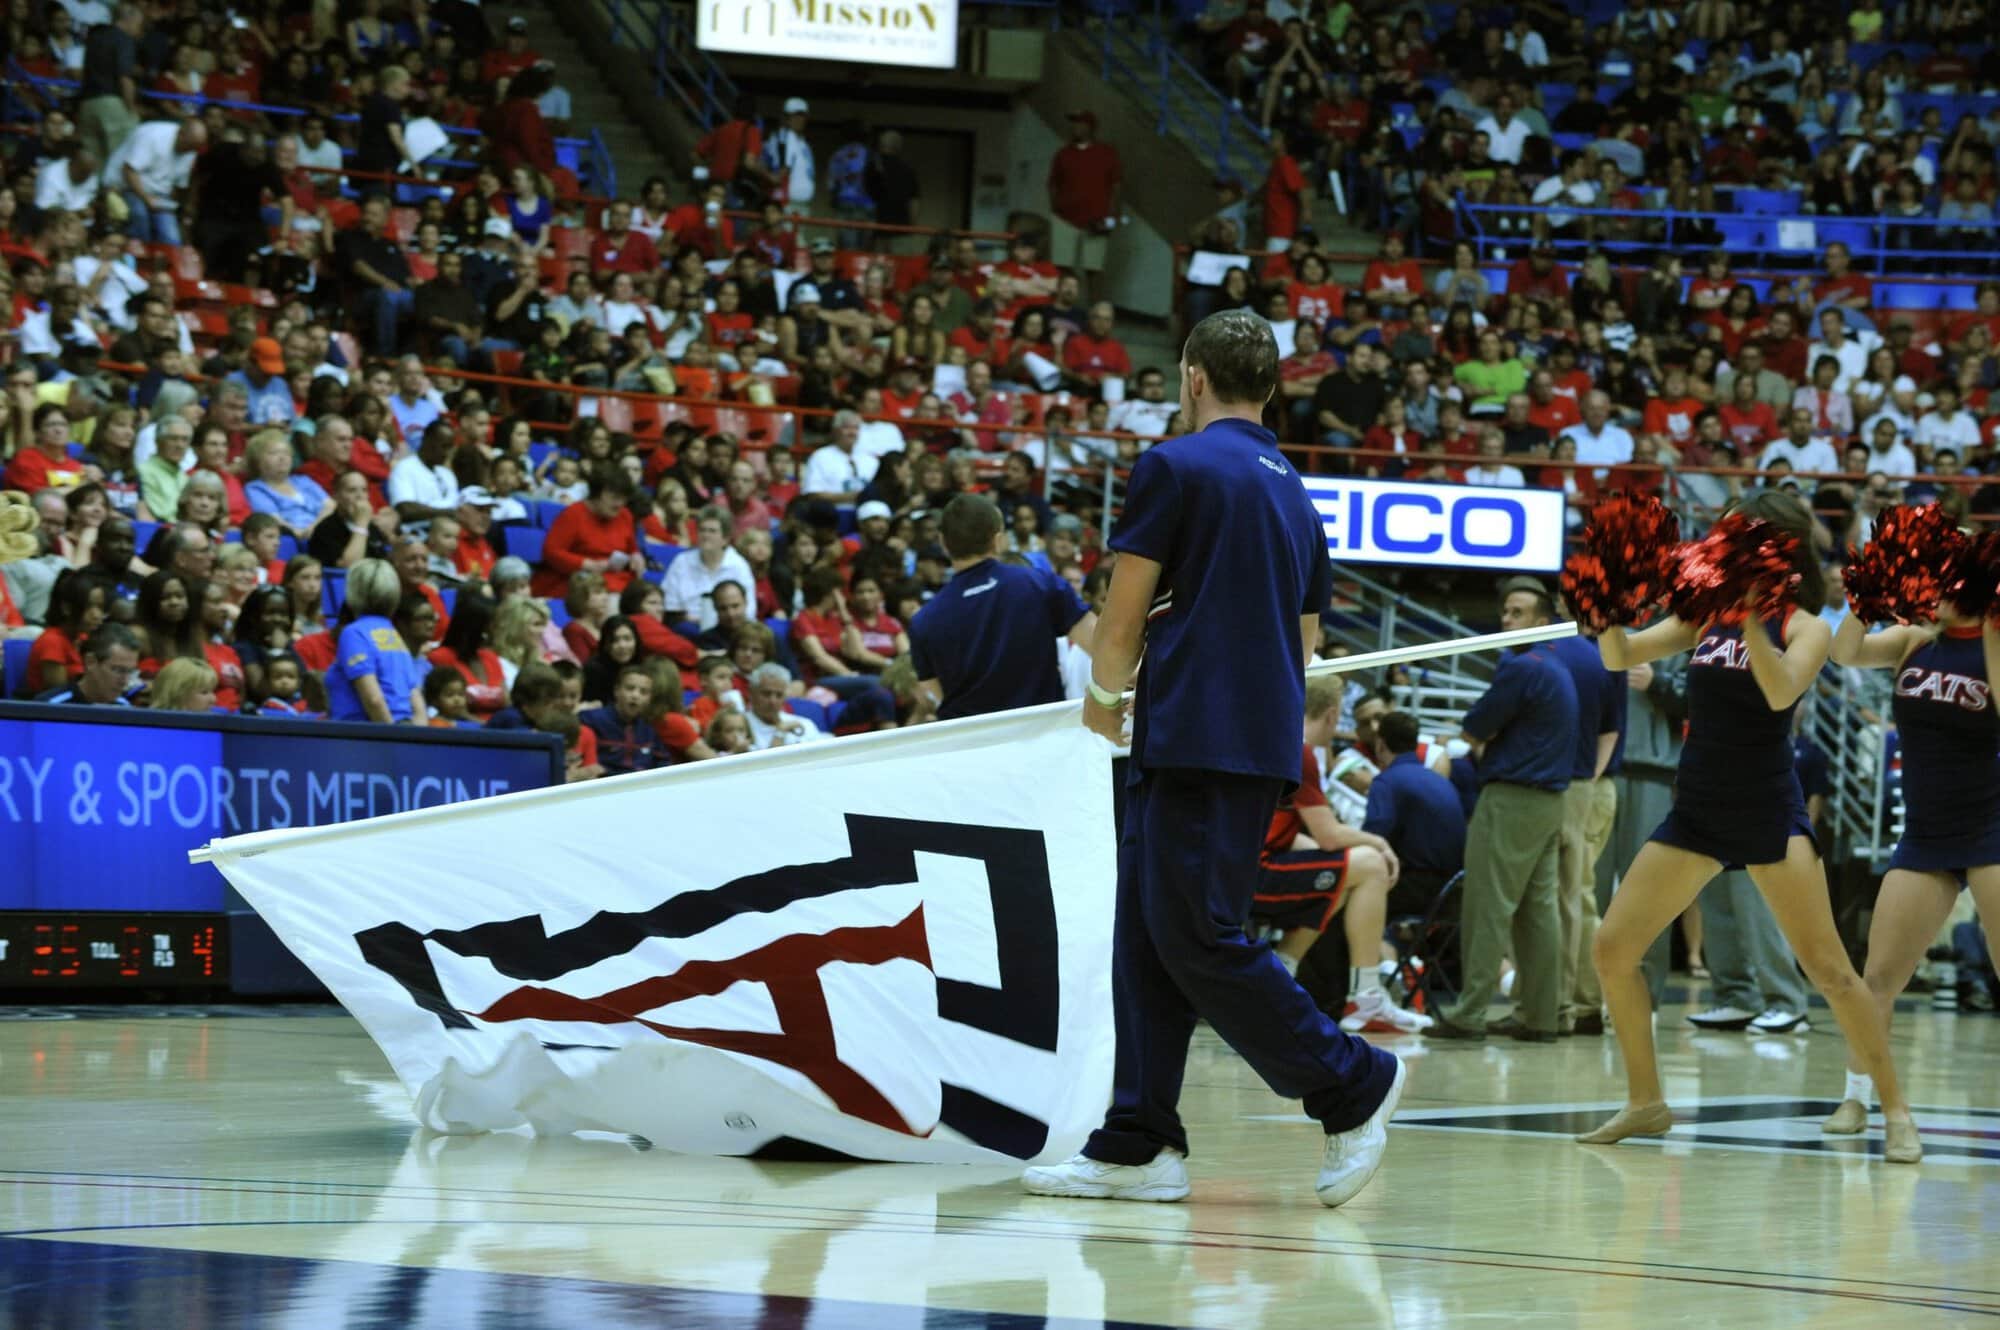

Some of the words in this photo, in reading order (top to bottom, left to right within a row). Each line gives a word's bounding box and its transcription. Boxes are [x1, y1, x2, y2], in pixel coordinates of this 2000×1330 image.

[1306, 489, 1526, 558] EICO
[1690, 636, 1751, 670] CAT
[1896, 667, 1990, 711] CATS
[69, 760, 102, 826] &
[117, 762, 292, 829] SPORTS
[307, 769, 510, 828] MEDIC
[193, 927, 214, 976] 4
